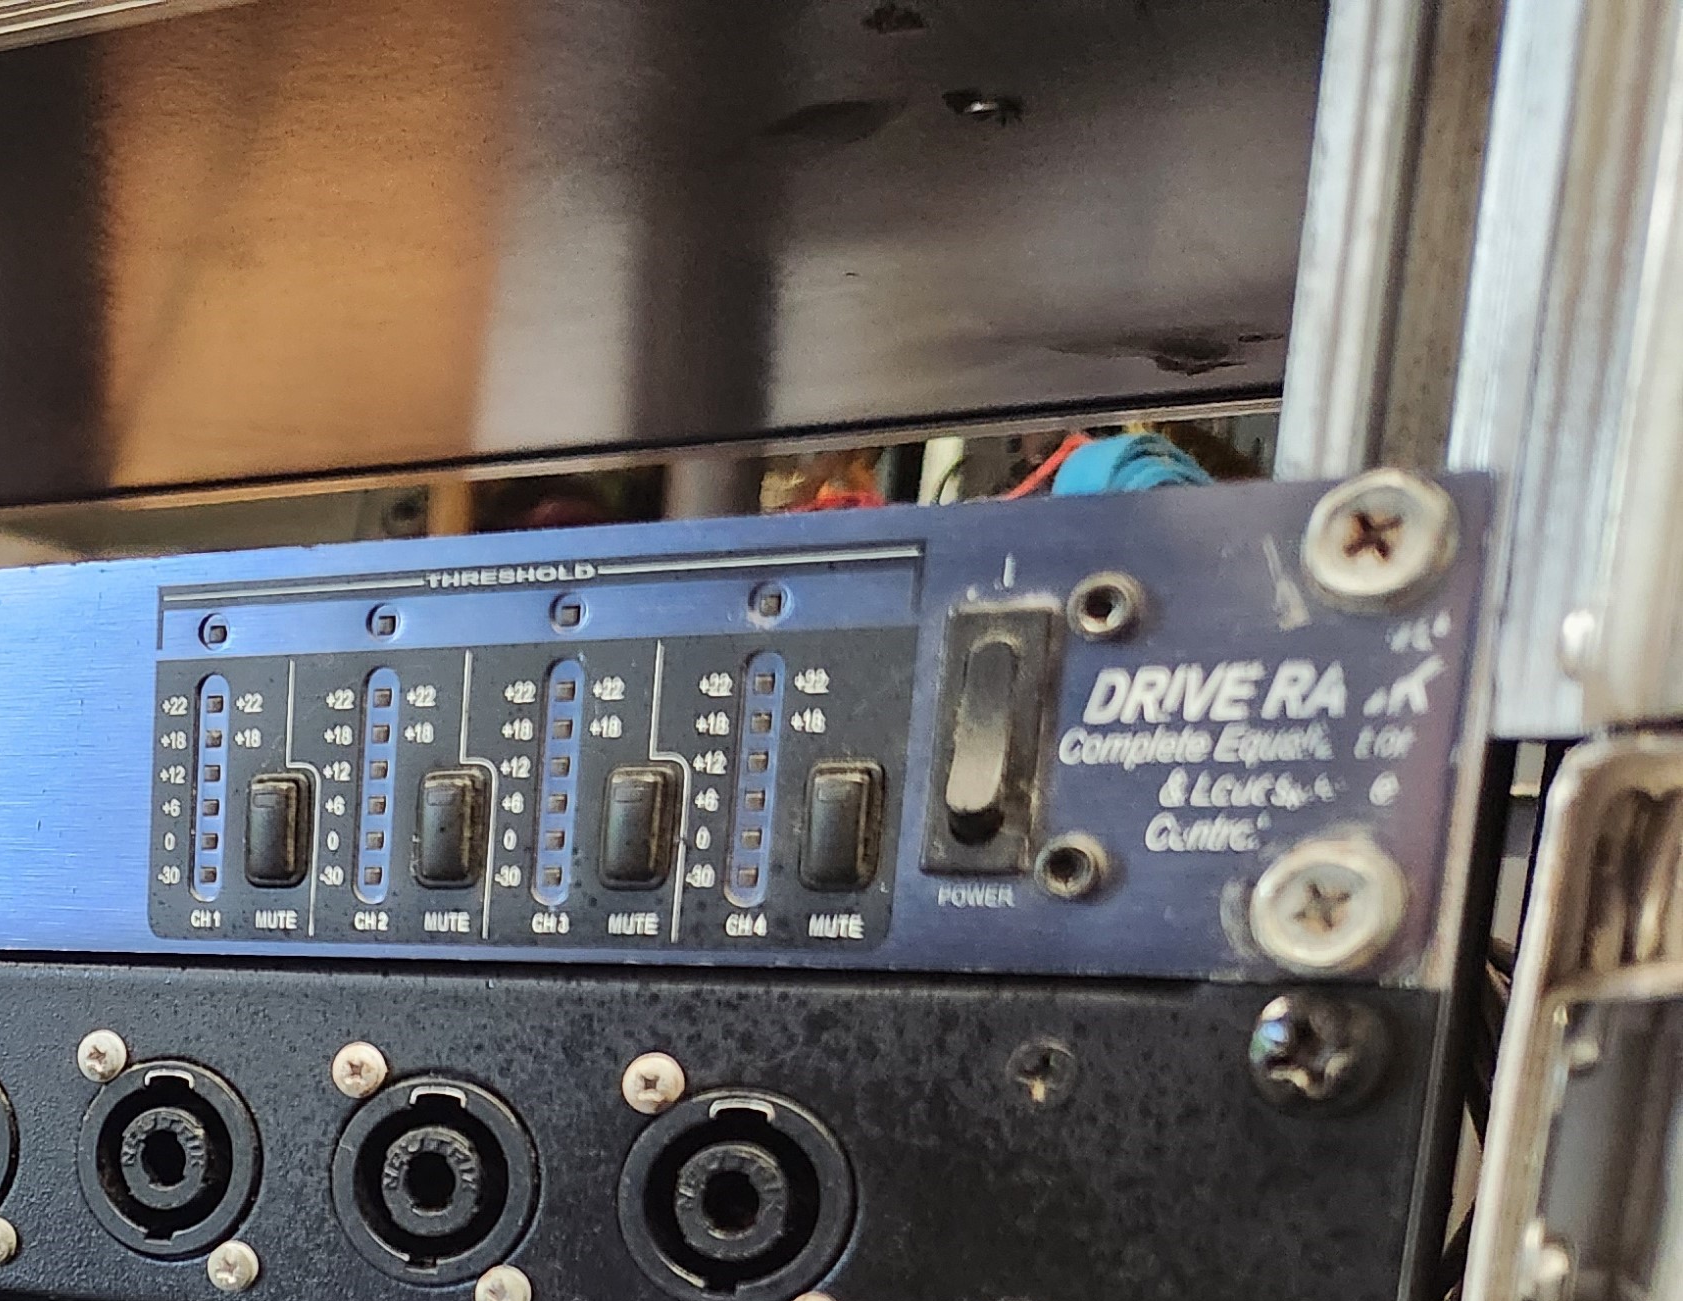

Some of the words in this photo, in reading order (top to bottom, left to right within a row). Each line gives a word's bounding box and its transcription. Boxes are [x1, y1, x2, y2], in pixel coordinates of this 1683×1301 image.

[426, 563, 596, 588] THRESHOLD
[326, 689, 355, 709] +22
[407, 685, 436, 707] +22
[1083, 659, 1268, 725] DRIVE
[1261, 654, 1446, 721] RAK
[162, 696, 188, 716] +22
[236, 693, 263, 713] +22
[161, 731, 187, 750] +18
[235, 728, 262, 748] +18
[324, 725, 353, 745] +18
[405, 722, 434, 743] +18
[1059, 725, 1215, 771] Complete
[160, 765, 186, 784] +12
[323, 761, 351, 781] +12
[1159, 766, 1188, 808] &
[162, 798, 181, 817] +6
[325, 795, 345, 815] +6
[164, 832, 175, 851] 0
[327, 831, 340, 851] 0
[158, 866, 180, 885] -30
[320, 865, 344, 885] -30
[938, 882, 1016, 908] POWER
[255, 910, 298, 930] MUTE
[424, 911, 470, 933] MUTE
[608, 912, 659, 935] MUTE
[808, 913, 865, 939] MUTE
